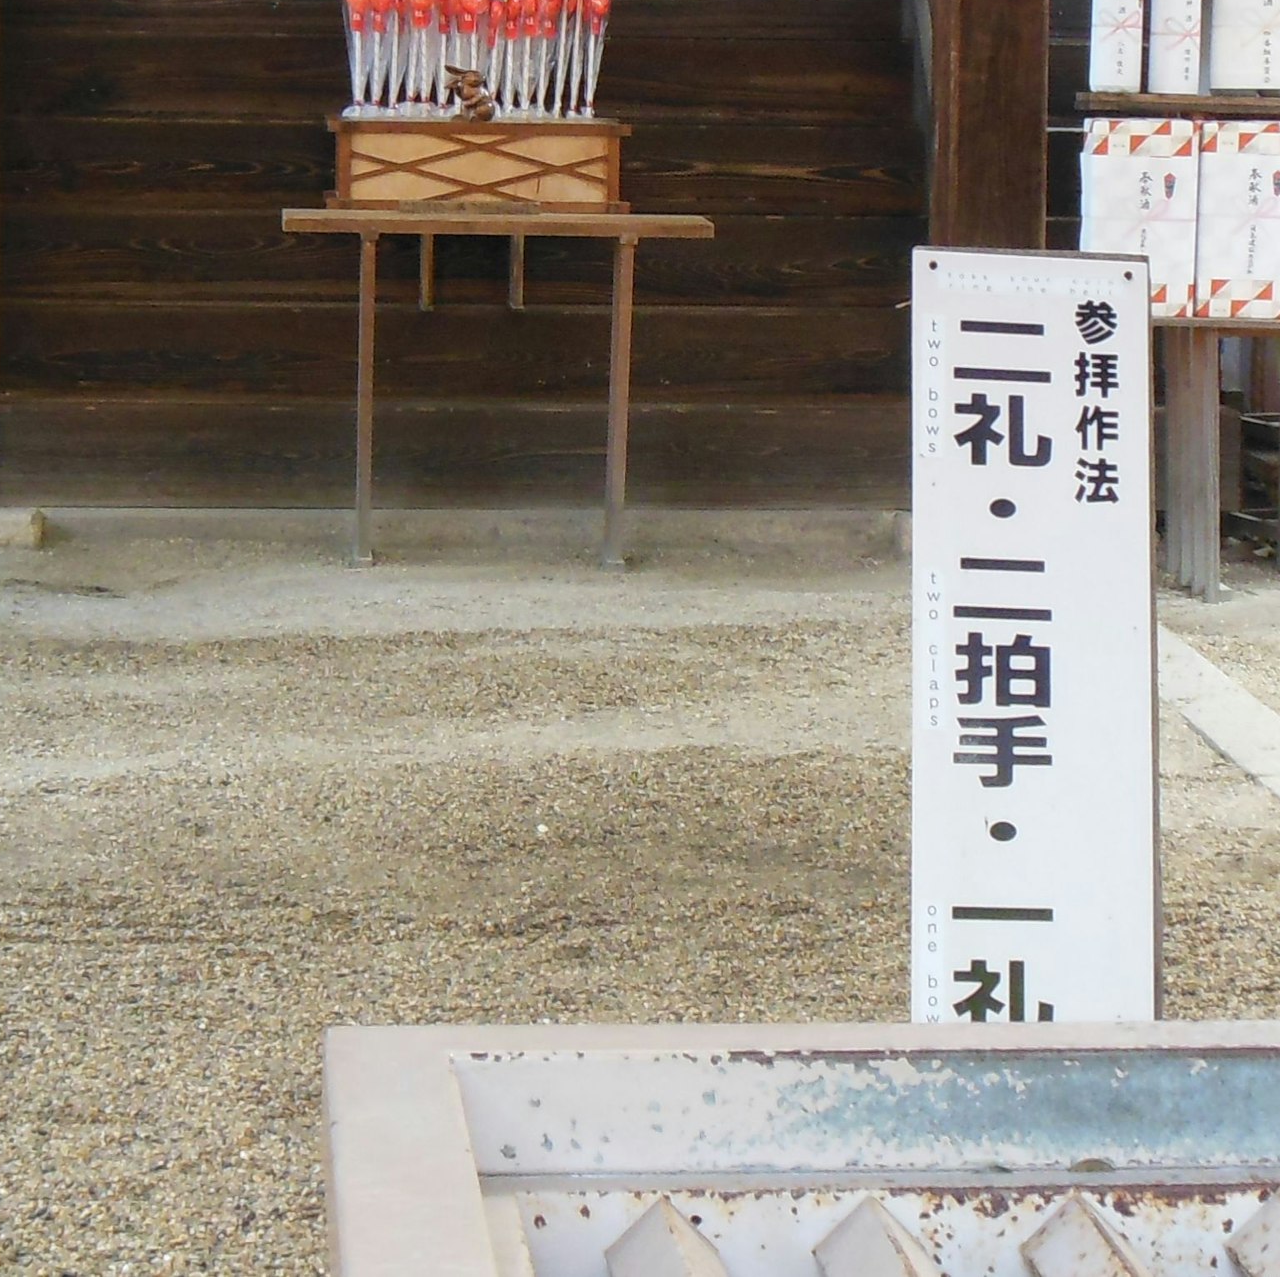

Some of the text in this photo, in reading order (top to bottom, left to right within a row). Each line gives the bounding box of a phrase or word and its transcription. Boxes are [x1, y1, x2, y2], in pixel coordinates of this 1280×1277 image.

[926, 320, 940, 453] two bows
[1074, 300, 1120, 505] 参拝作法
[926, 572, 940, 727] two claps
[927, 905, 937, 953] one
